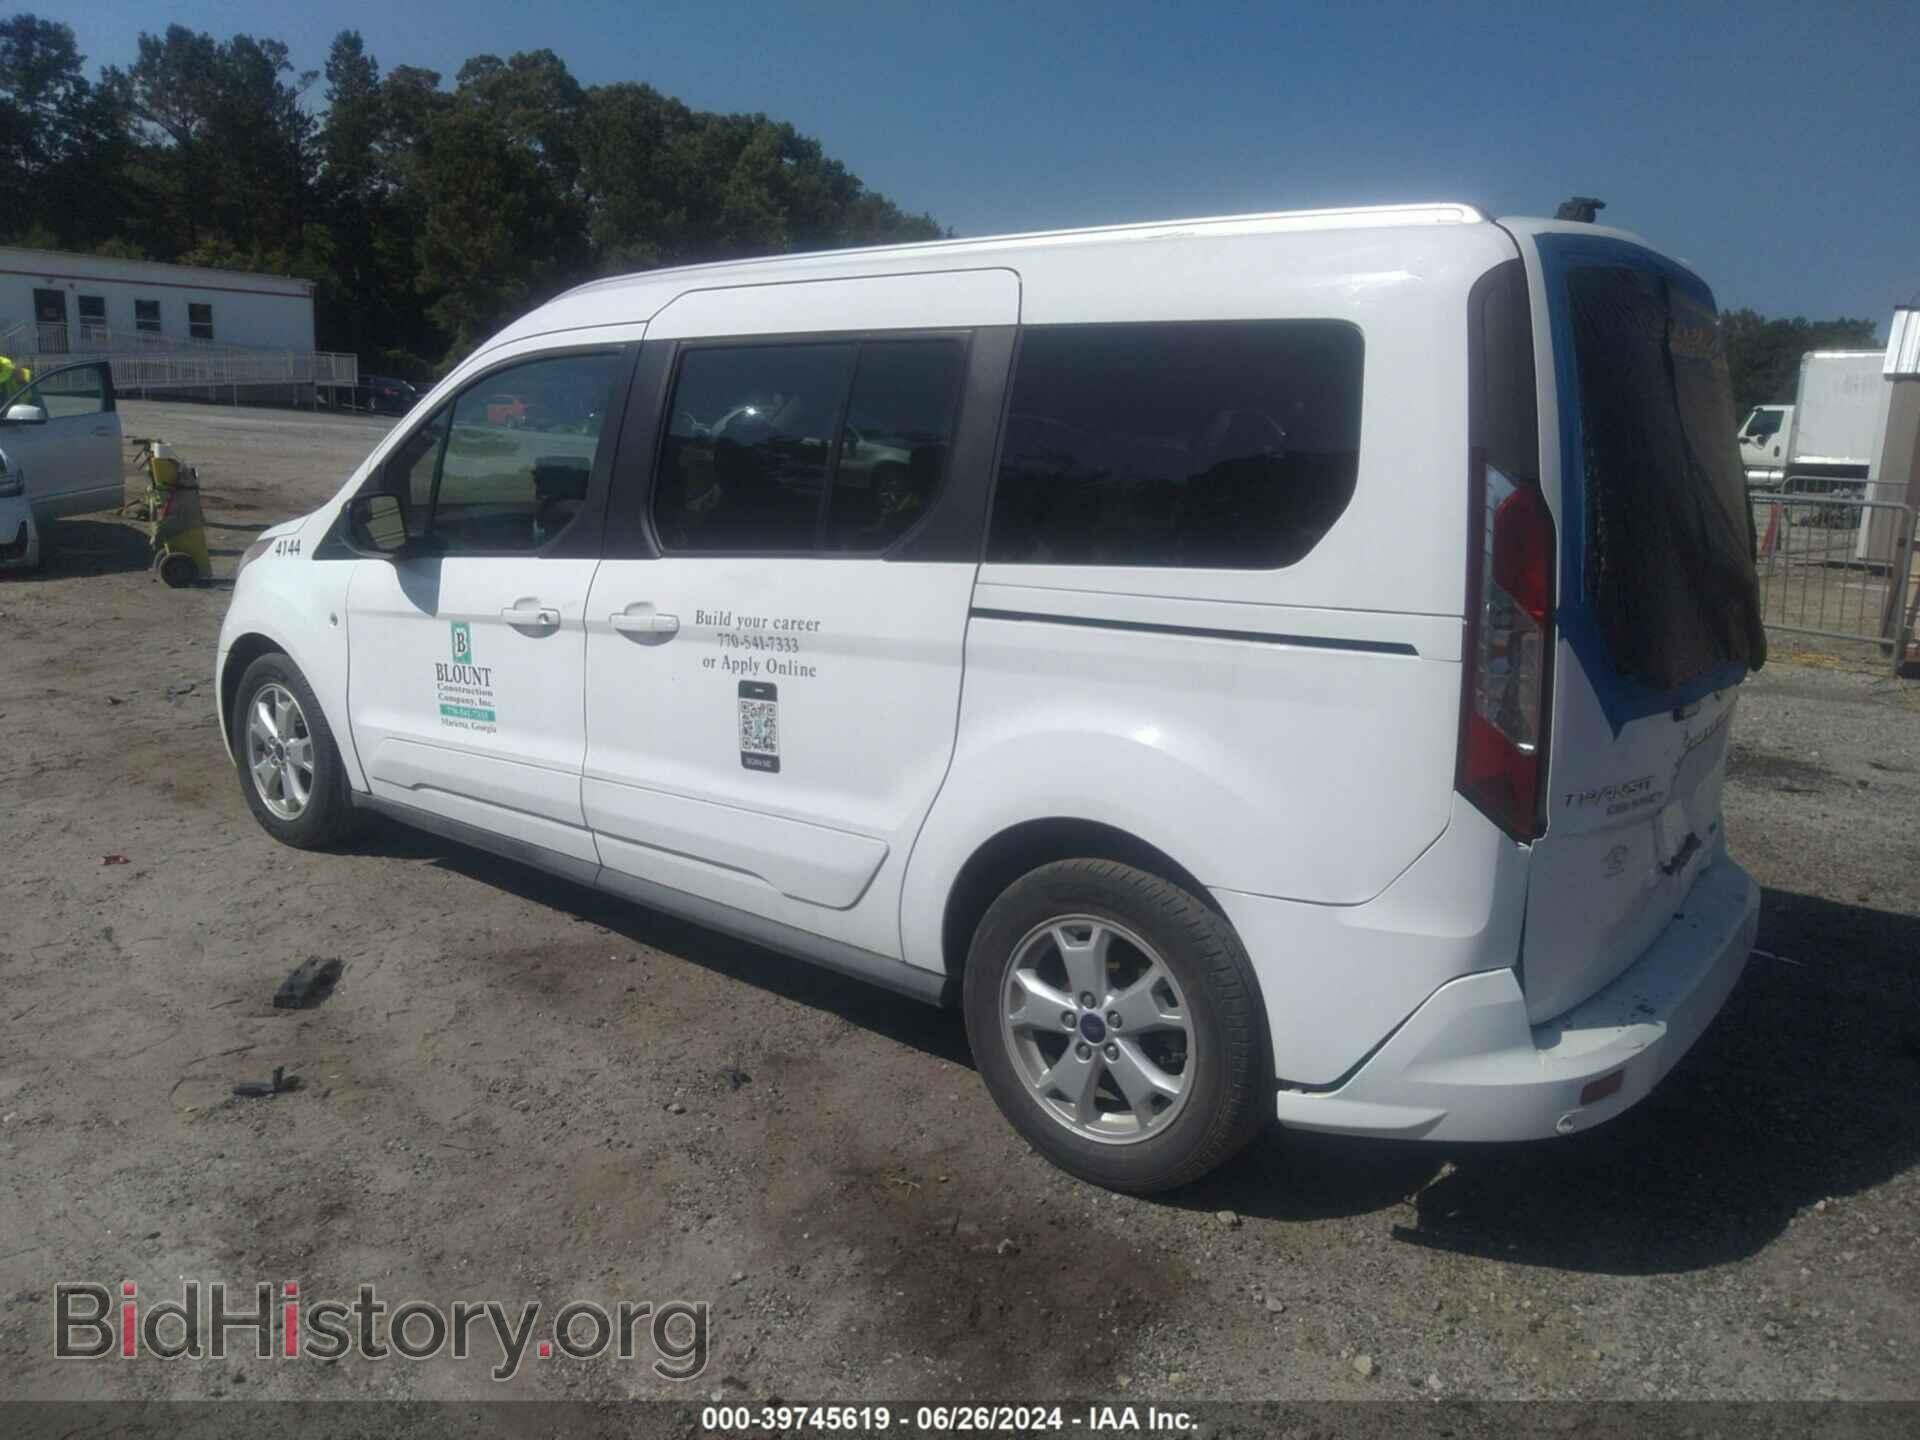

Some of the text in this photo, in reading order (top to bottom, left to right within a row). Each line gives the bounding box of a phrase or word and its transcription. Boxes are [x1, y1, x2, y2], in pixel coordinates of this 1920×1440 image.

[275, 540, 301, 557] 4144
[695, 609, 821, 632] Build your career
[456, 631, 466, 653] B
[717, 632, 799, 653] 770-541-7333
[435, 662, 492, 687] BLOUNT
[702, 654, 817, 678] or Apply Online
[437, 683, 494, 697] Construction
